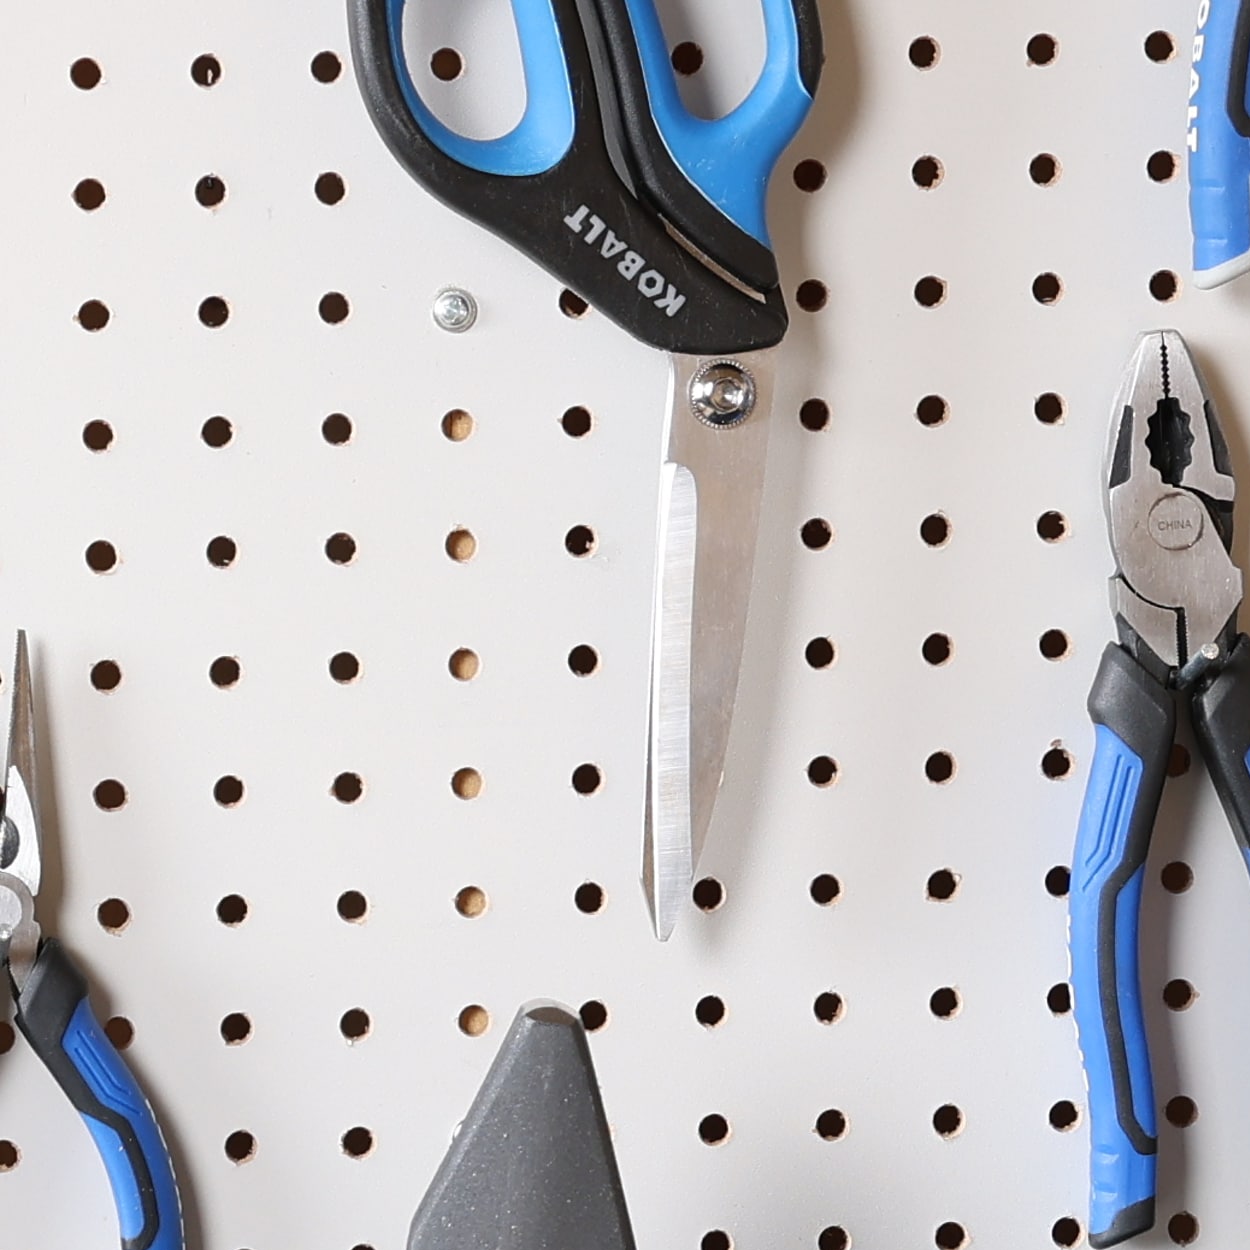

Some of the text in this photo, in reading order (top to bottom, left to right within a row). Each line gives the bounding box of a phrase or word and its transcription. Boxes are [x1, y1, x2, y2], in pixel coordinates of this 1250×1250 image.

[1187, 0, 1210, 152] OBALT
[563, 204, 686, 317] KOBALT
[1157, 519, 1193, 531] CHINA
